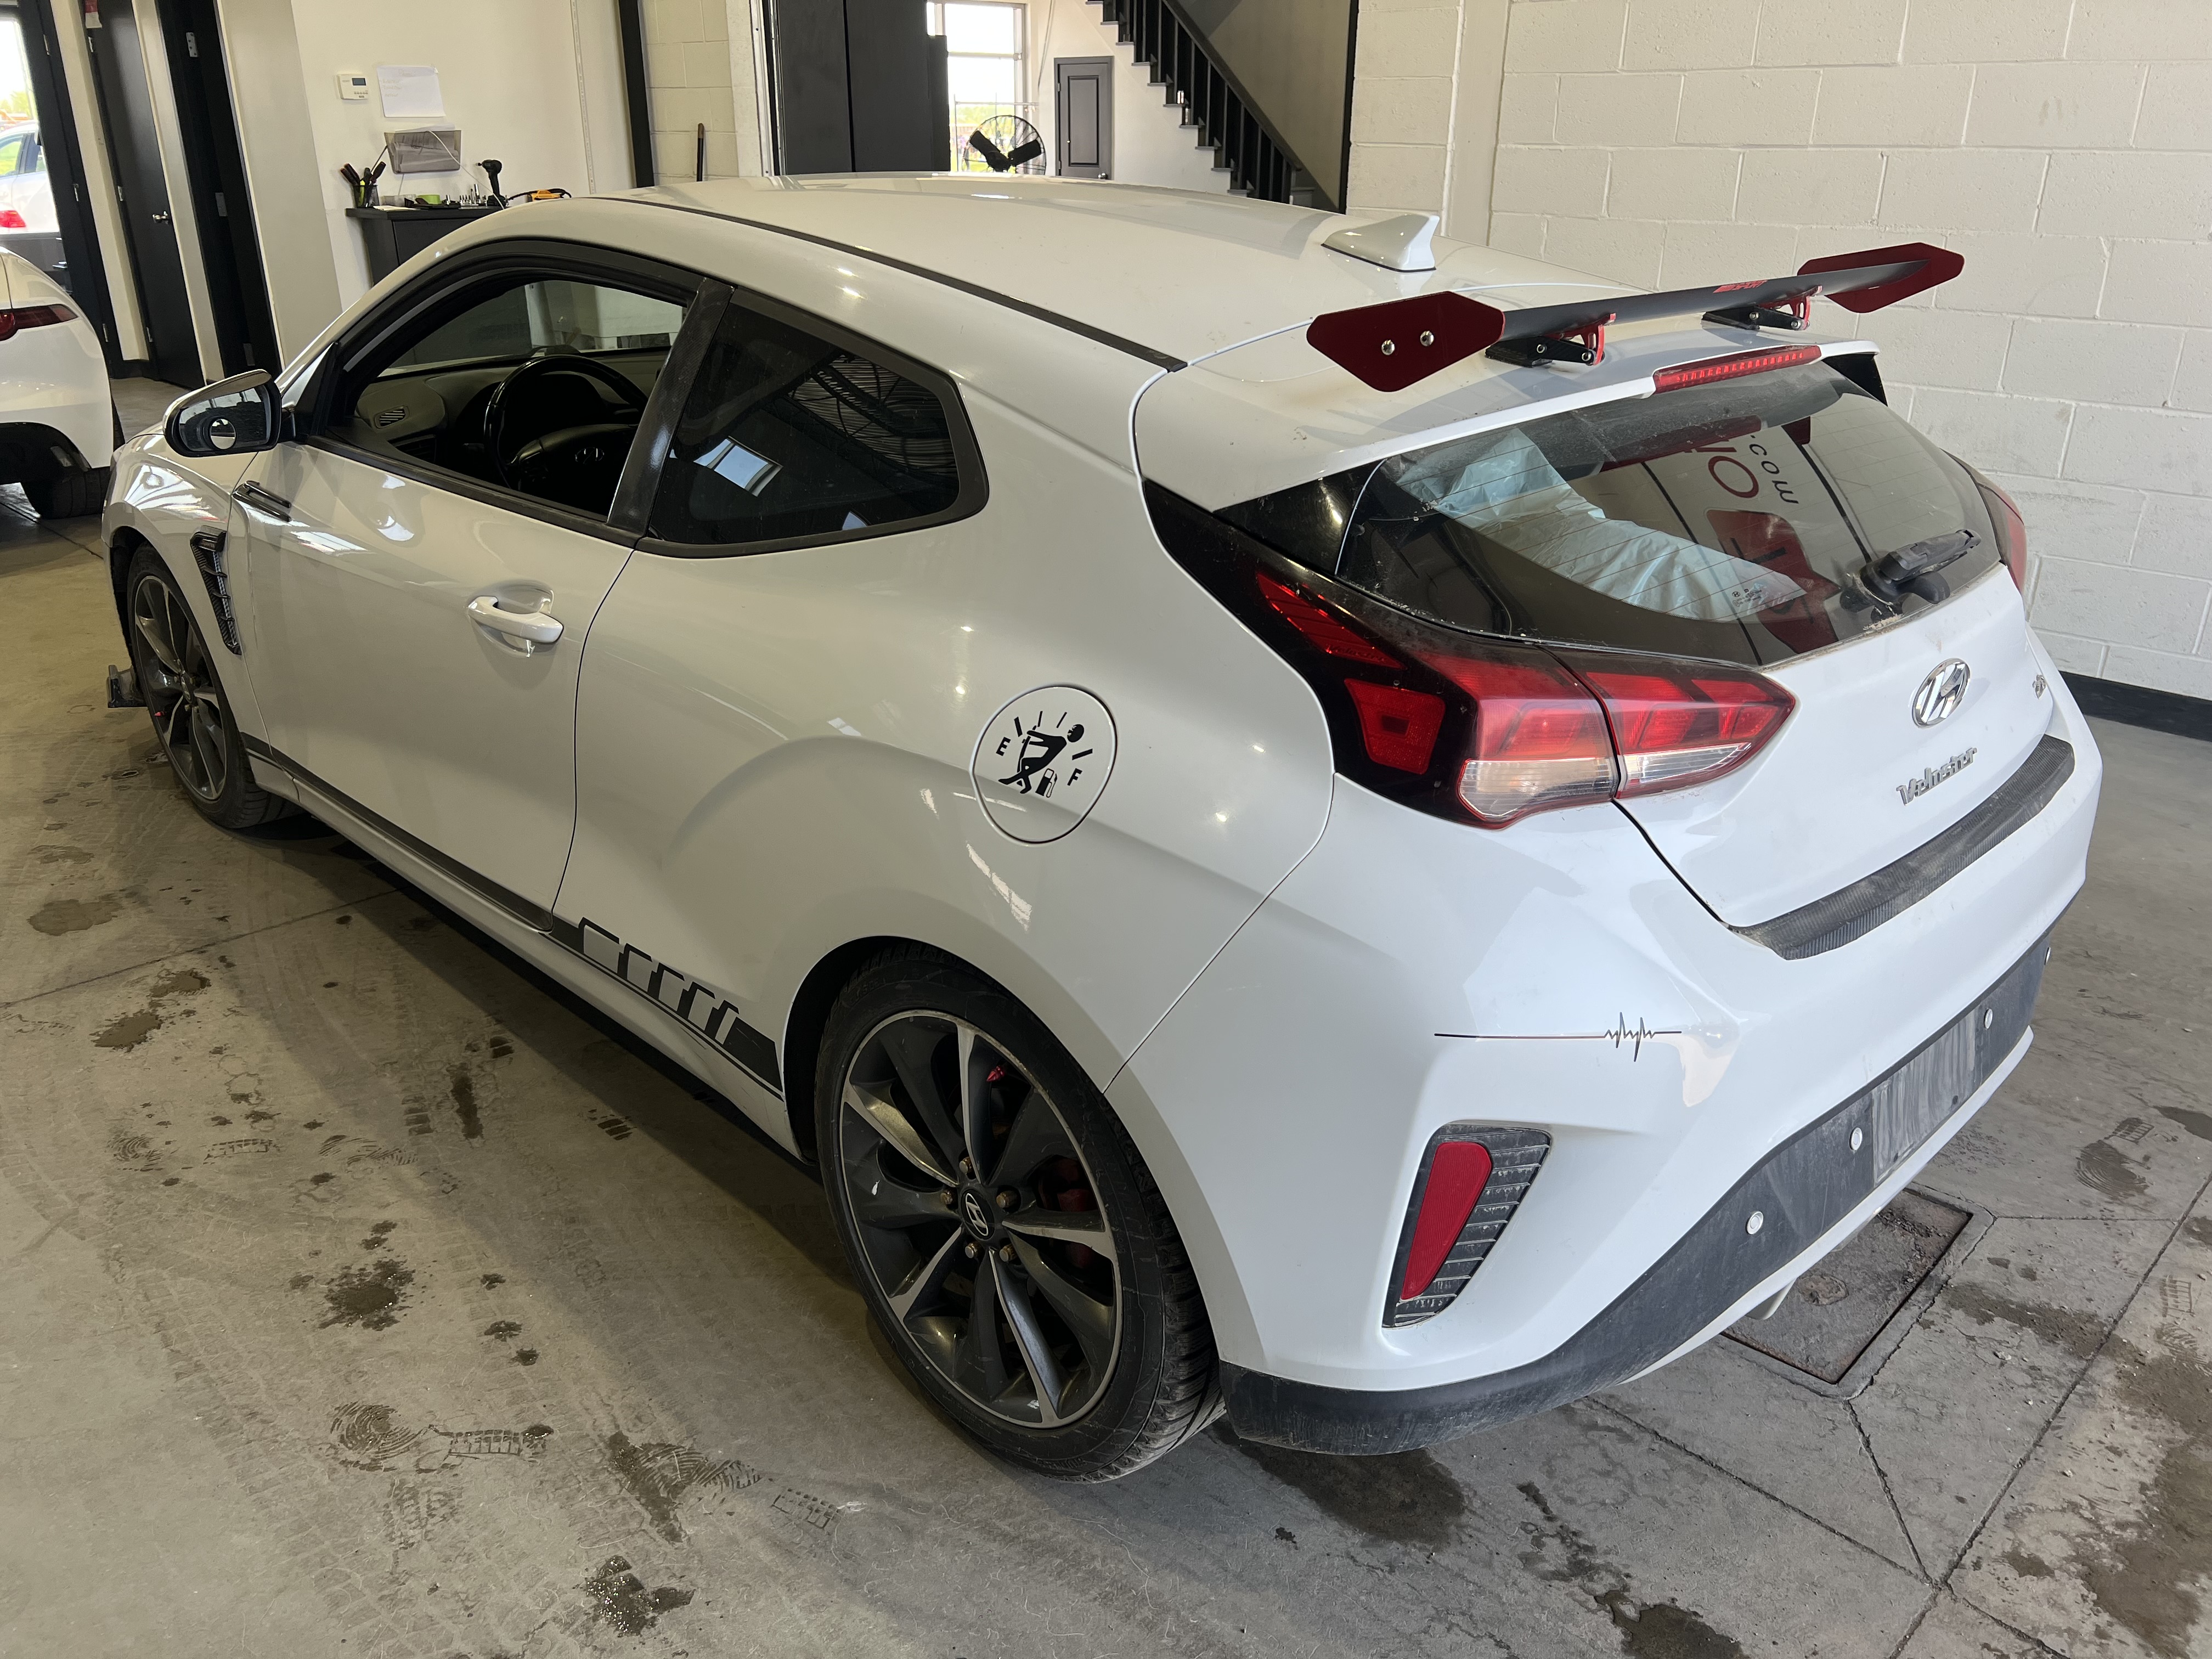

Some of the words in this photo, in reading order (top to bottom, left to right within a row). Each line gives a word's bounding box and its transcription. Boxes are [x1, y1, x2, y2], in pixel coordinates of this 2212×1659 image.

[996, 737, 1011, 757] E
[1067, 768, 1082, 786] F
[1896, 747, 1977, 806] Veloster
